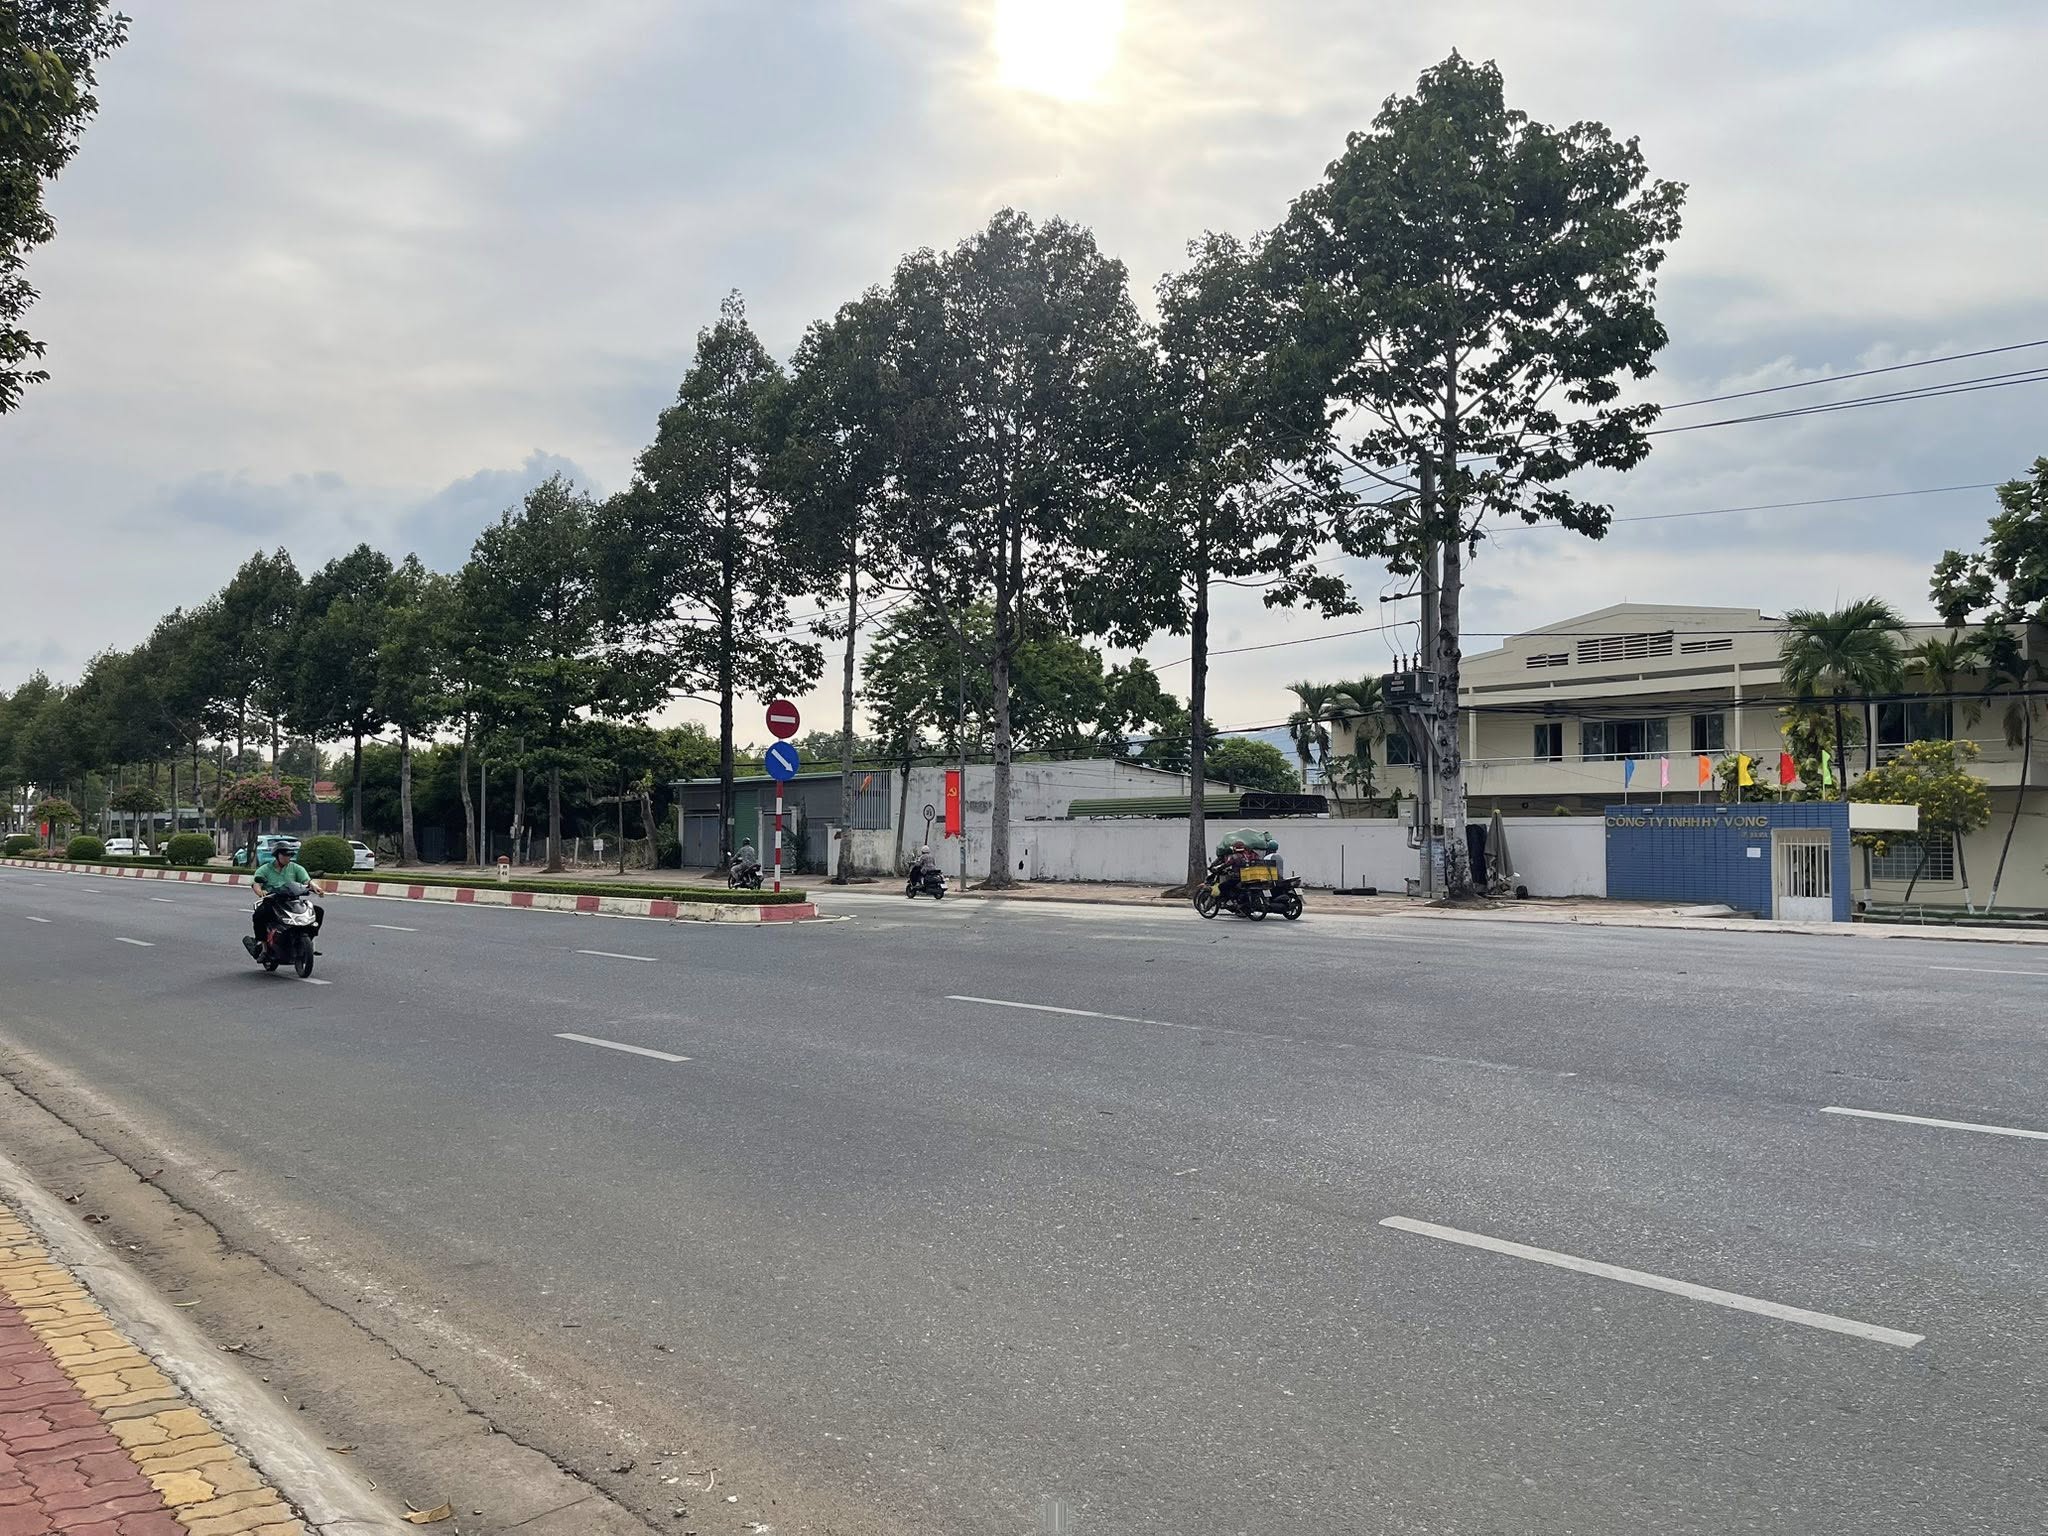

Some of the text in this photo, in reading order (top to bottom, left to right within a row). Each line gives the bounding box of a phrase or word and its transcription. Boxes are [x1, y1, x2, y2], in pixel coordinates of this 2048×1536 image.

[1606, 814, 1645, 827] CÔNG
[1648, 817, 1664, 827] TY
[1667, 817, 1700, 827] TNHH
[1724, 816, 1768, 830] VỌNG
